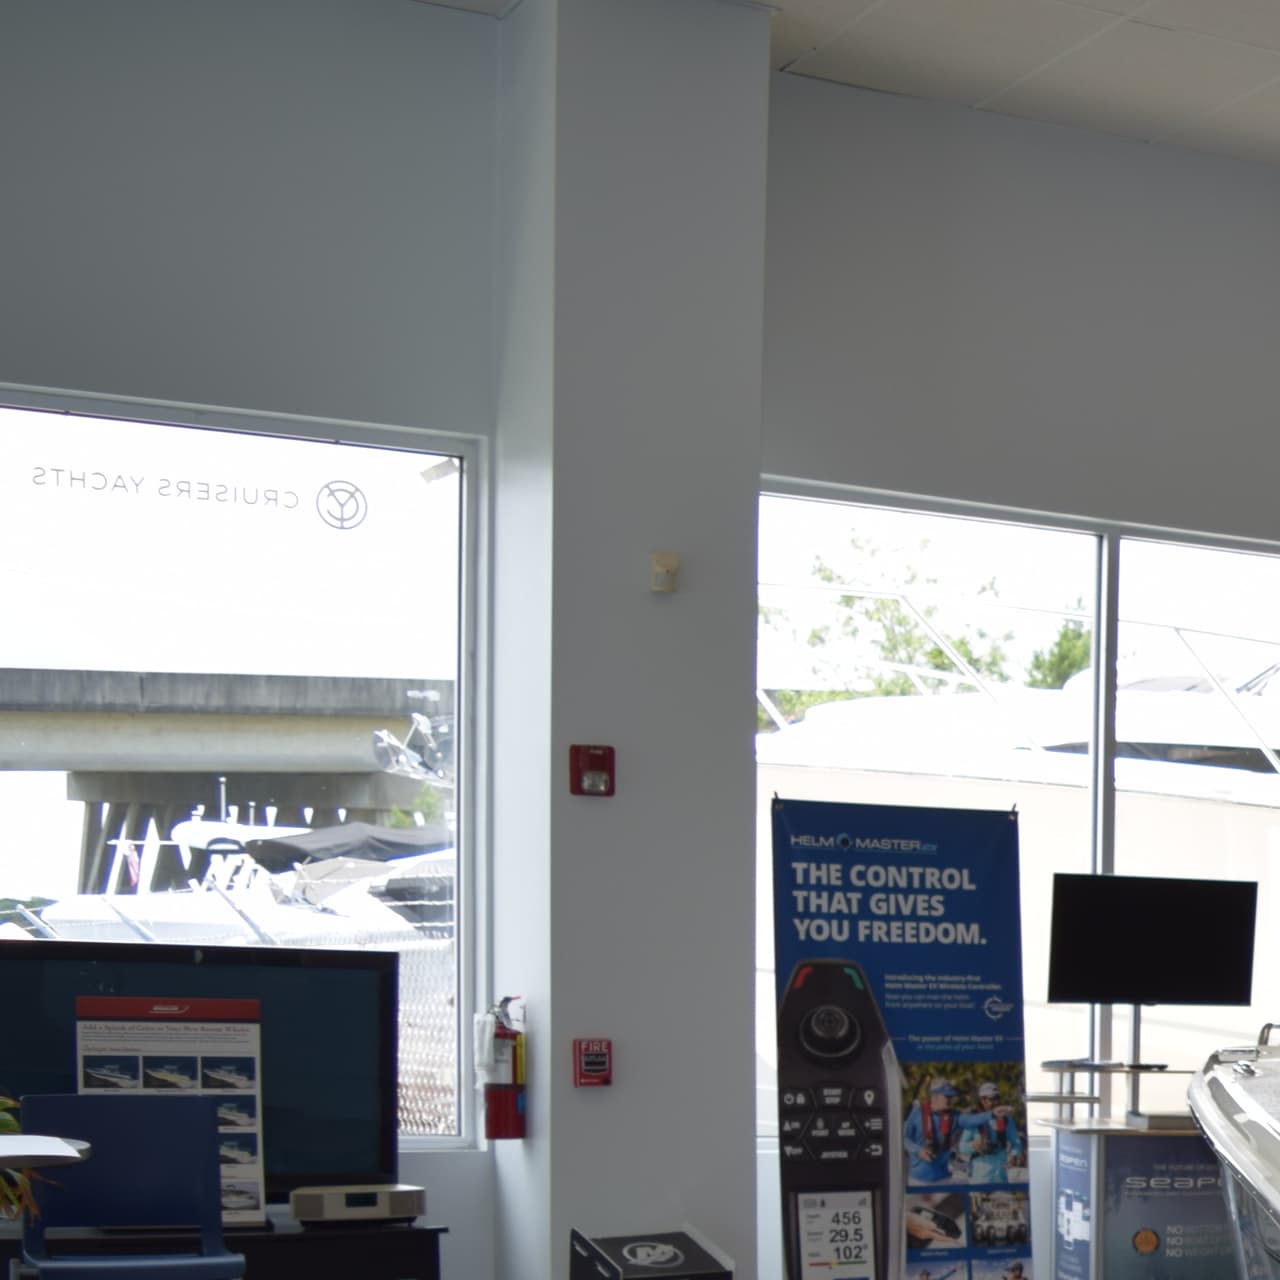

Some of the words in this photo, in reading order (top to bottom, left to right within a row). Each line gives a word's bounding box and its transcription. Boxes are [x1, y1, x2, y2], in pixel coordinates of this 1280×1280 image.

[791, 834, 834, 847] HELM
[856, 838, 920, 850] MASTER
[792, 862, 842, 886] THE
[850, 865, 976, 890] CONTROL
[793, 891, 862, 914] THAT
[869, 893, 944, 916] GIVES
[793, 919, 849, 942] YOU
[858, 921, 988, 945] FREEDOM.
[581, 1041, 608, 1052] FIRE
[831, 1211, 861, 1225] 456
[829, 1227, 863, 1244] 29.5
[1166, 1225, 1183, 1233] NO
[1166, 1237, 1184, 1245] NO
[1166, 1248, 1182, 1257] NO
